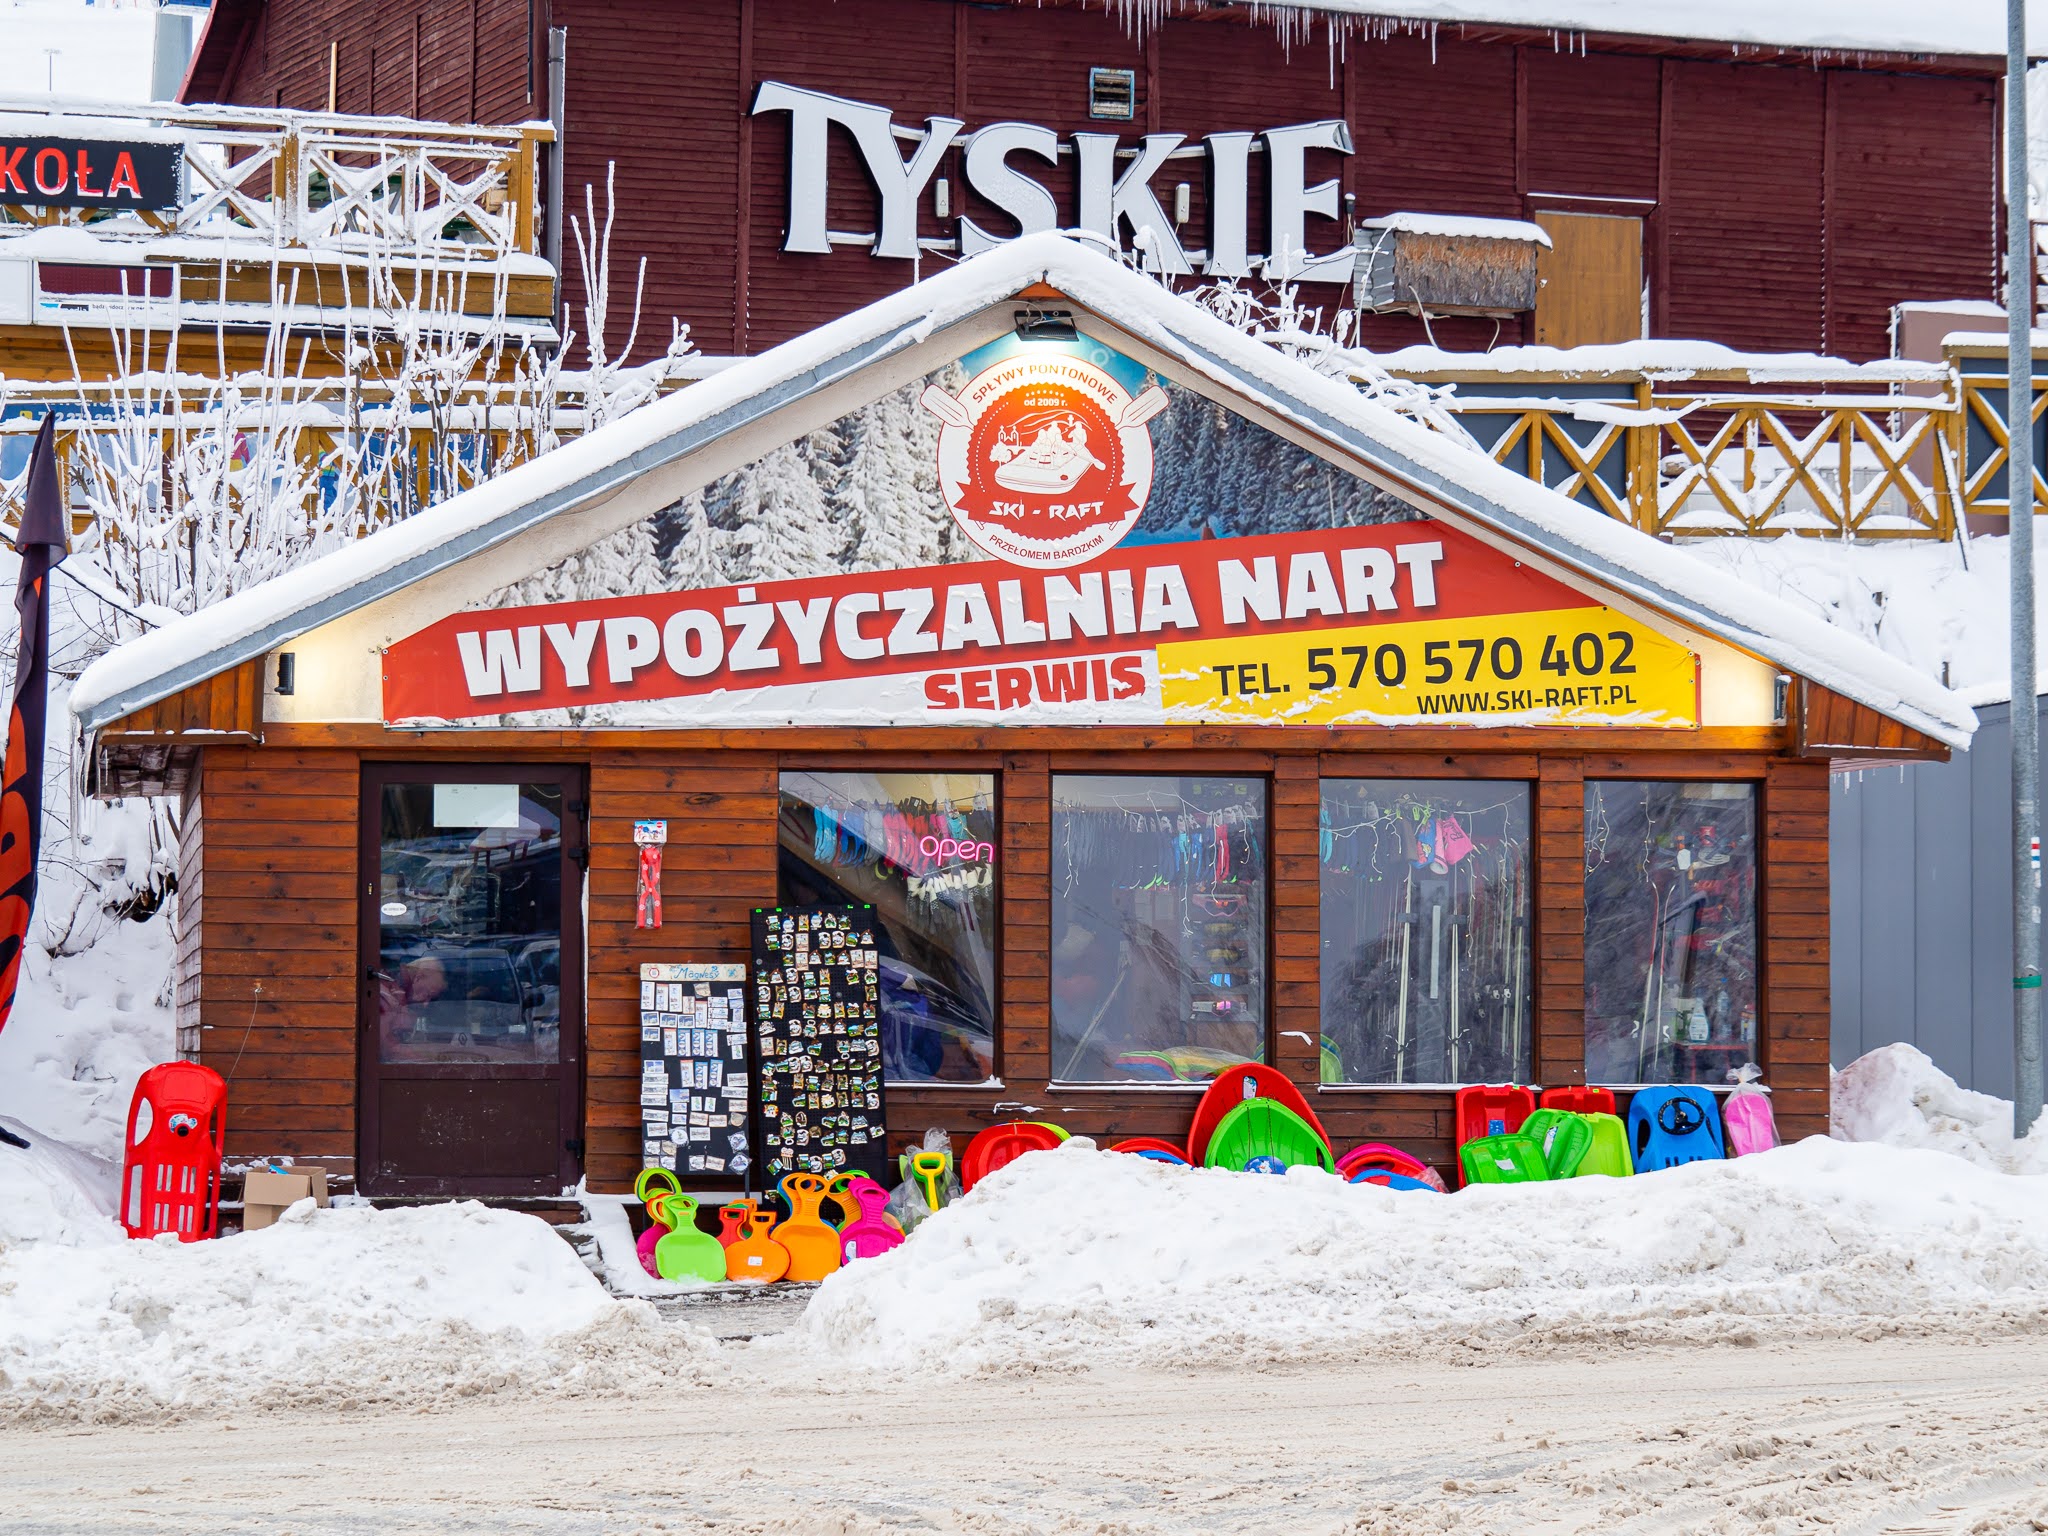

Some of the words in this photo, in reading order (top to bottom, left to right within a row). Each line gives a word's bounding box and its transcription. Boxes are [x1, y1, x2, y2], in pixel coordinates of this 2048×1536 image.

[751, 81, 1356, 283] TYSKIE
[972, 366, 1025, 404] SPŁYWY
[1029, 364, 1118, 404] PONTONOWE
[1024, 397, 1036, 407] od
[1037, 398, 1060, 407] 2009
[988, 500, 1025, 520] SKI
[1048, 501, 1105, 521] RAFT
[988, 534, 1052, 560] PRZEŁOMEM
[1053, 534, 1105, 560] BARDZKIM
[456, 564, 1200, 697] WYPOŻYCZALNIA
[1217, 541, 1444, 625] NART
[1212, 662, 1290, 696] TEL.
[1307, 643, 1407, 690] 570
[1424, 637, 1523, 684] 570
[1539, 631, 1637, 677] 402
[923, 656, 1146, 711] SERWIS
[1416, 685, 1637, 715] WWW.SKI-RAFT.PL
[920, 835, 994, 867] open
